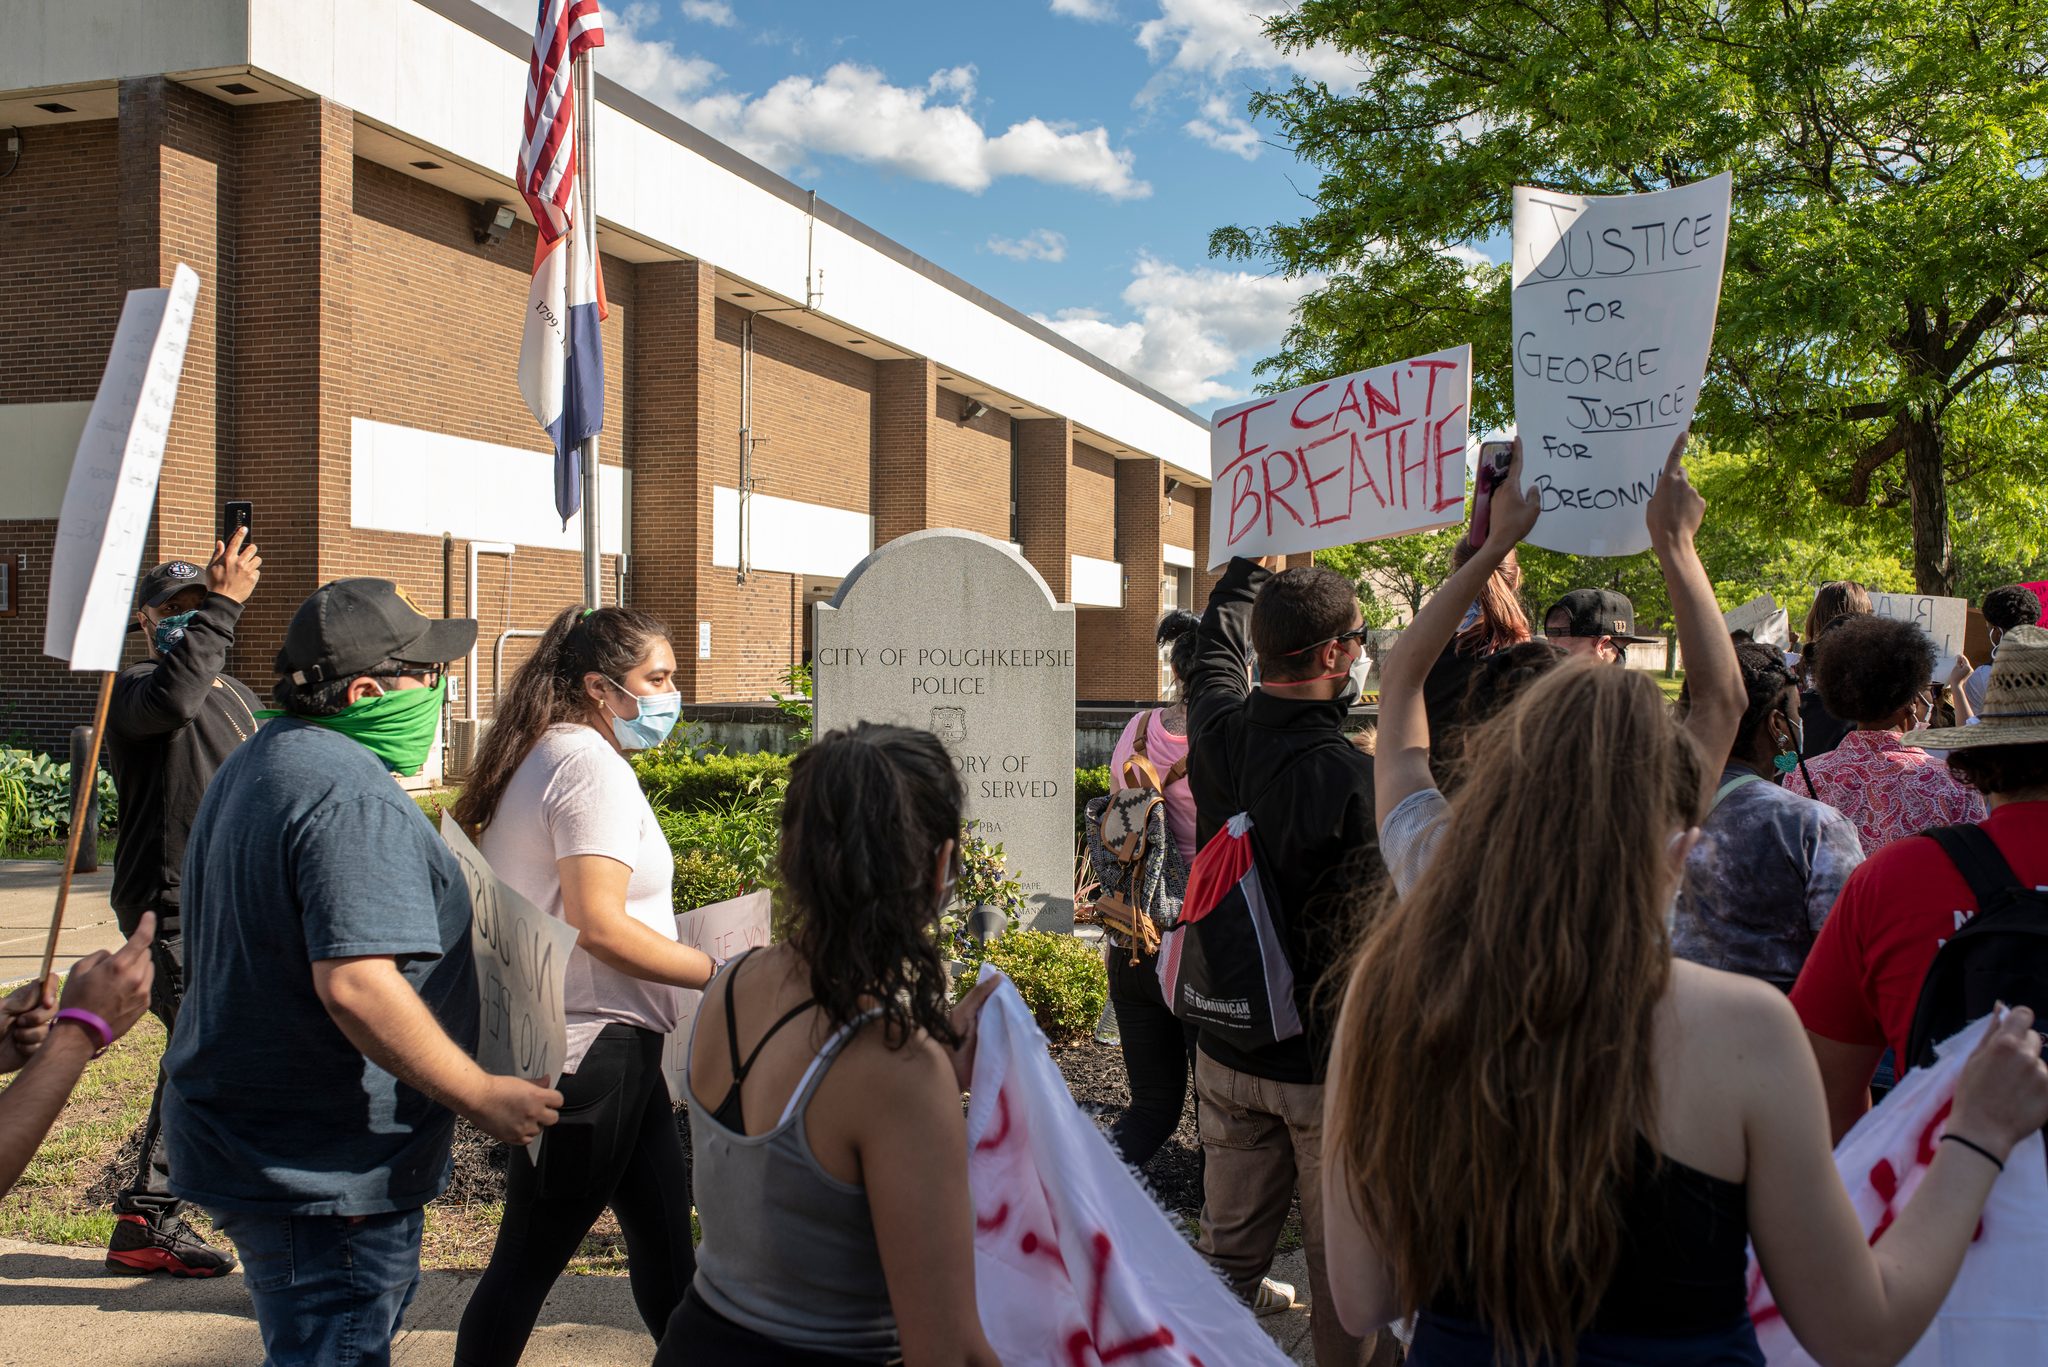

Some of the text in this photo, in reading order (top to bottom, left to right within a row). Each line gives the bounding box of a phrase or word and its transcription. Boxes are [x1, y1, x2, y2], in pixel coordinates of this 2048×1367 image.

[1529, 198, 1712, 279] JUSTICE
[535, 300, 559, 327] 1799
[1518, 332, 1660, 384] GEORGE
[1567, 385, 1686, 429] JUSTICE
[1217, 360, 1458, 481] I CAN'T
[1543, 435, 1592, 460] FOR
[1227, 404, 1465, 546] BREATHE
[1534, 467, 1663, 512] BREONN
[819, 648, 1074, 667] CITY OF POUGHKEEPSIE
[912, 676, 985, 695] POLICE
[950, 755, 1030, 773] ORY OF
[980, 780, 1058, 798] SERVED
[979, 821, 1002, 832] PBA
[1195, 995, 1251, 1014] DOMINICAN
